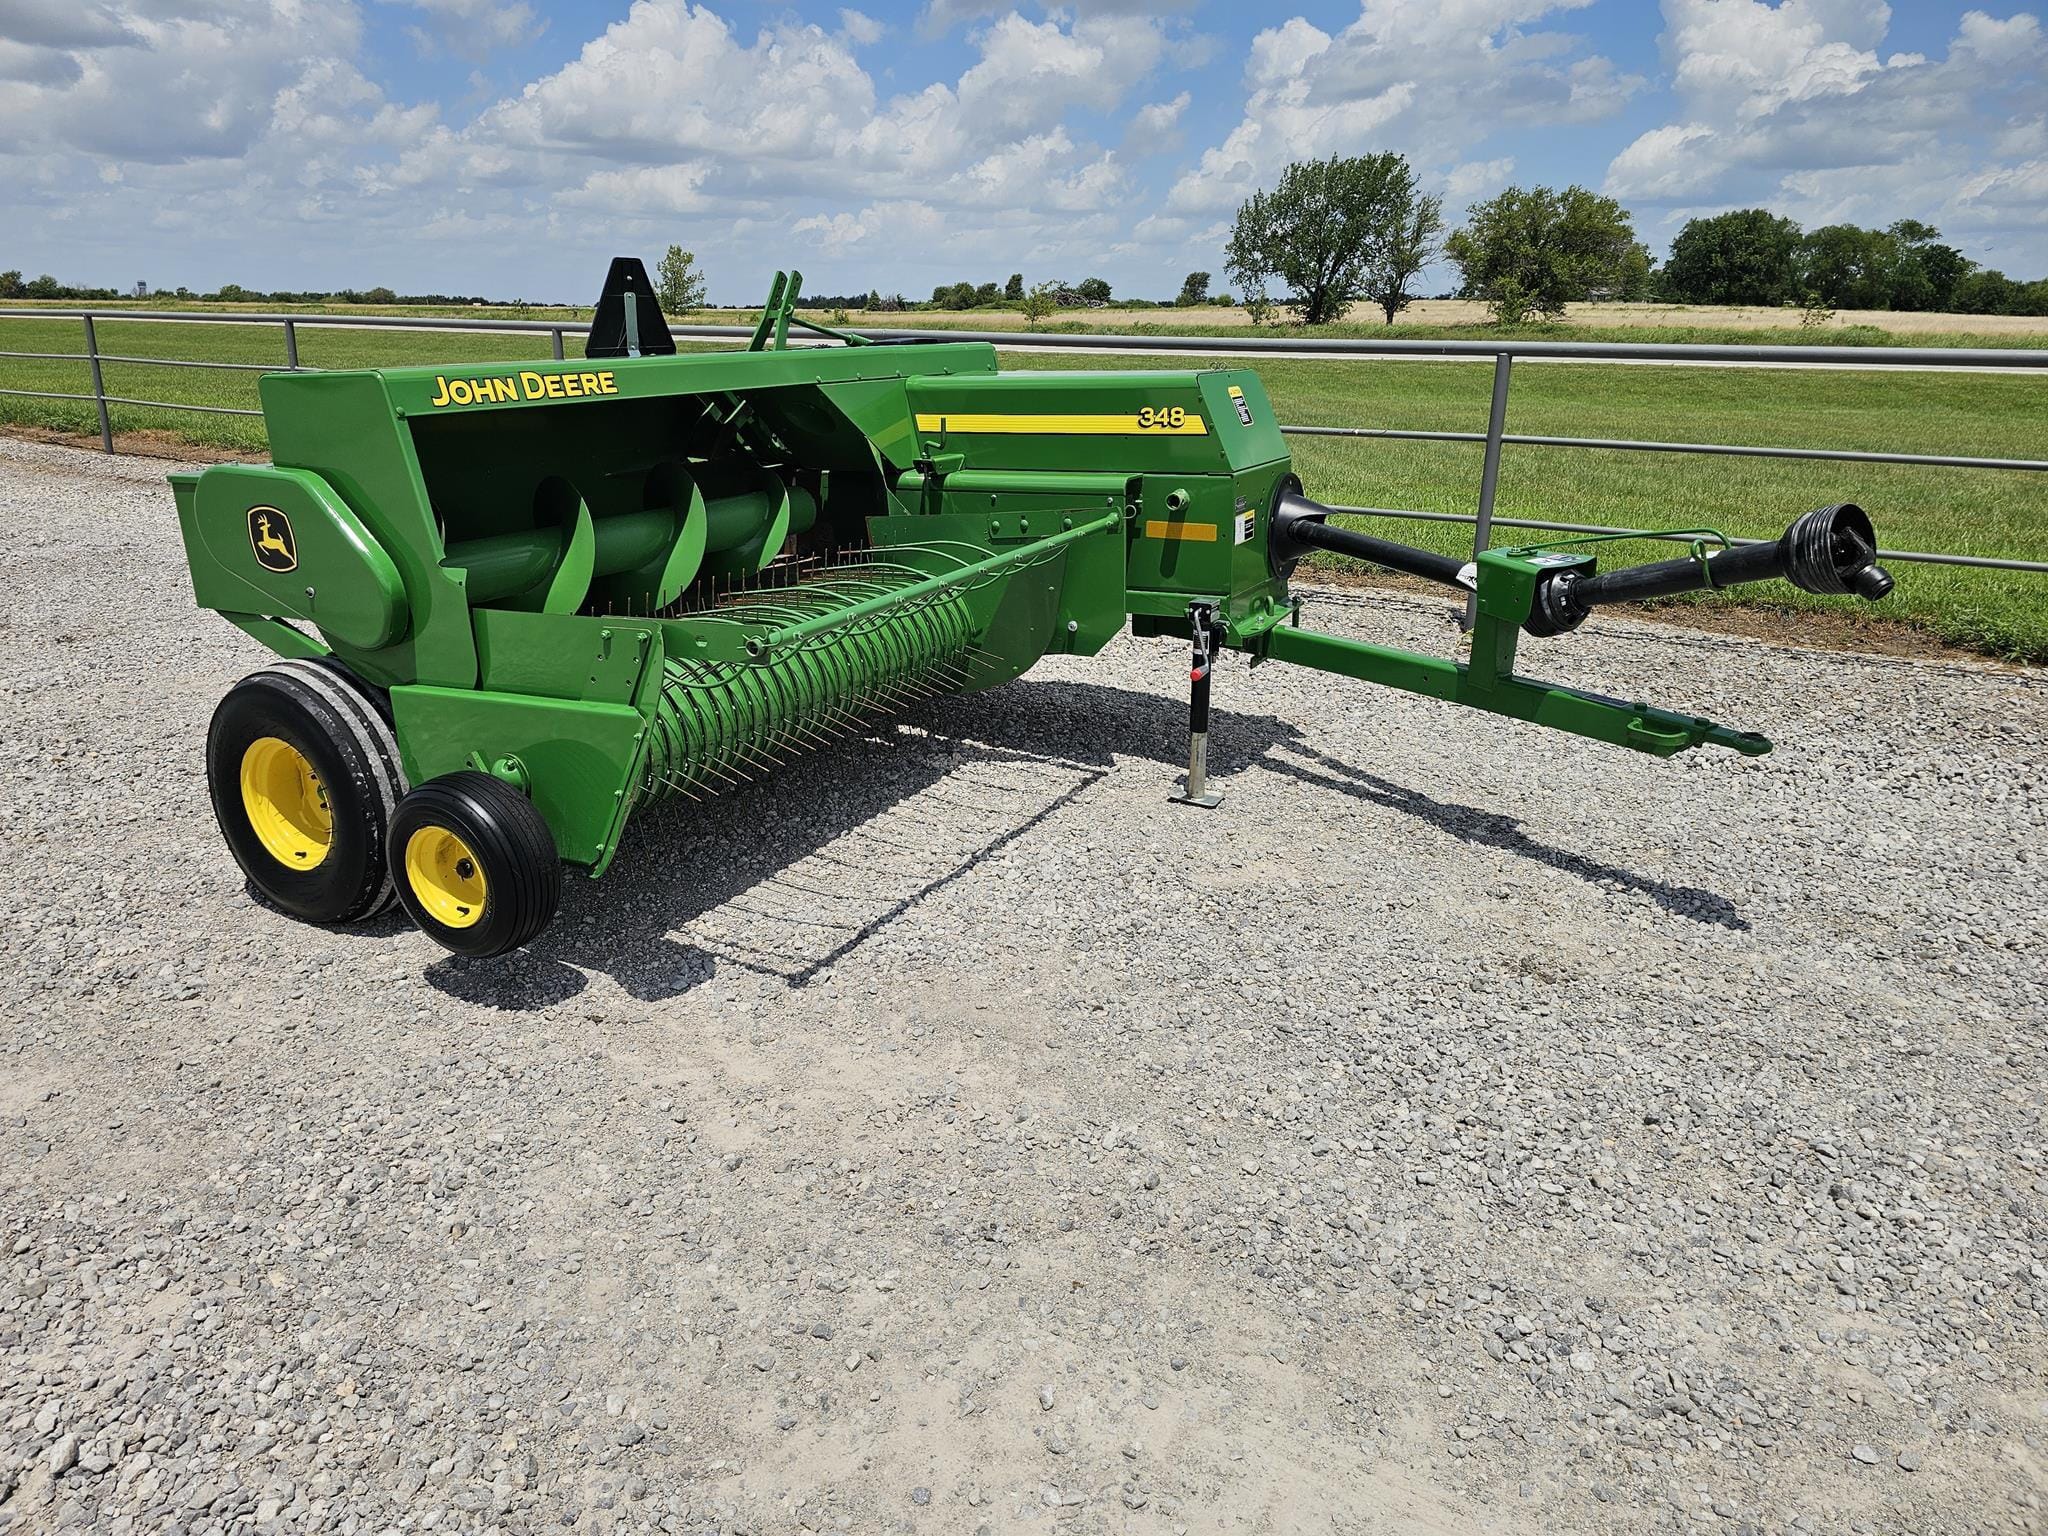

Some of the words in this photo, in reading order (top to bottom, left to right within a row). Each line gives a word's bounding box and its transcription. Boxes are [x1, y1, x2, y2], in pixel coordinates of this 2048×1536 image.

[431, 375, 519, 407] JOHN
[519, 370, 618, 400] DEERE
[1138, 407, 1186, 429] 348
